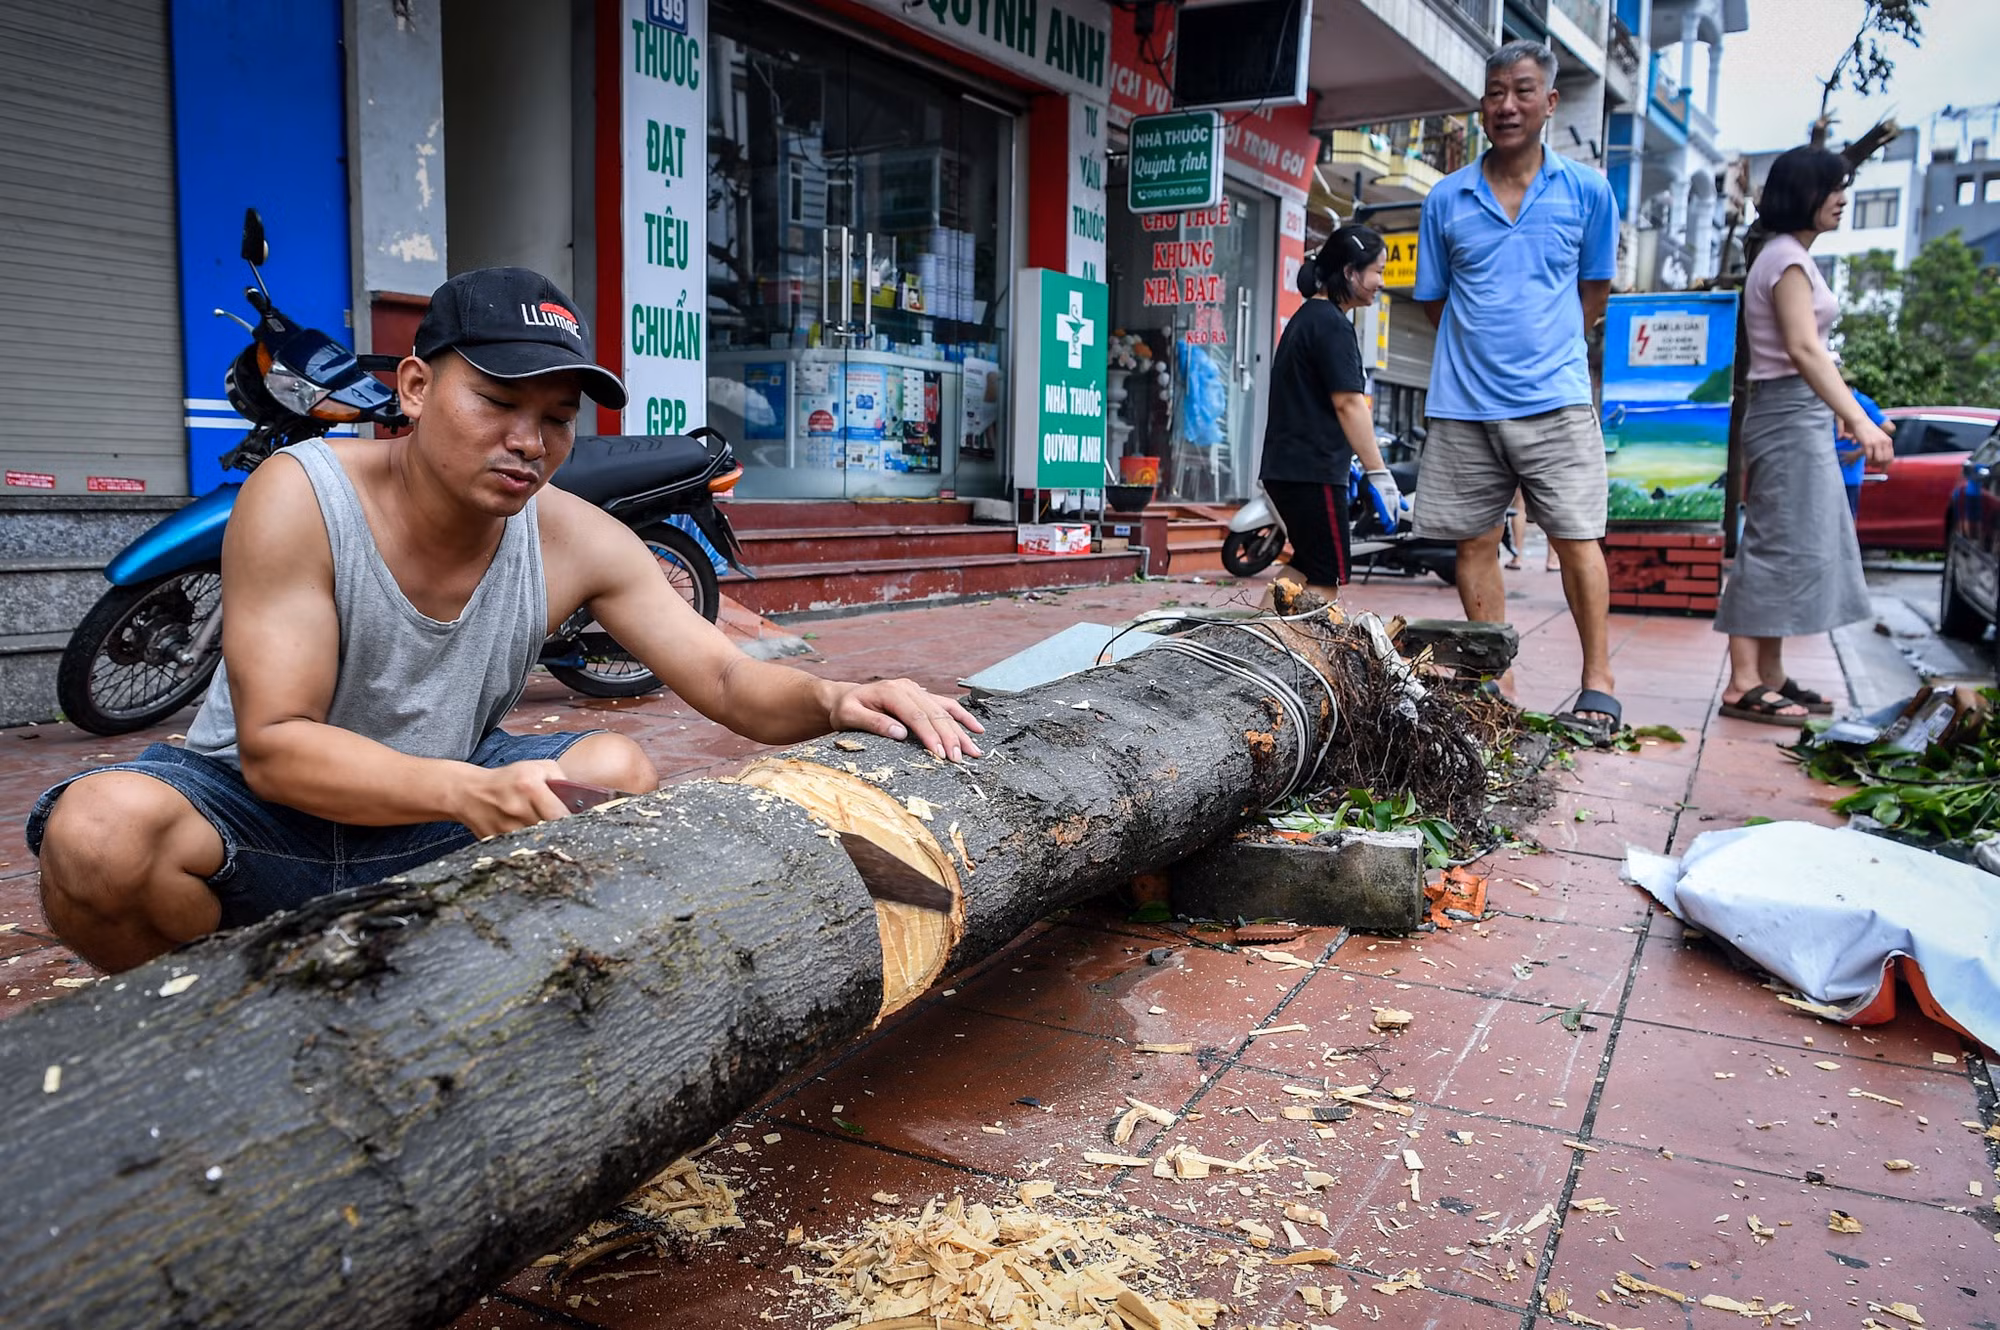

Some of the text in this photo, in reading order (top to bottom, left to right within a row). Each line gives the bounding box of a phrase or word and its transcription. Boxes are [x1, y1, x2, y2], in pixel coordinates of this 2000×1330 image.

[653, 0, 684, 24] 199
[1046, 8, 1105, 88] ANH
[646, 119, 687, 188] ĐẠT
[1136, 124, 1209, 148] NHÀ THUỐC
[1180, 151, 1208, 174] Anh
[644, 206, 688, 270] TIÊU
[1154, 241, 1213, 270] KHUNG
[1144, 269, 1219, 309] NHÀ BẠT
[632, 289, 701, 361] CHUẨN
[647, 397, 687, 436] GPP
[1045, 380, 1102, 417] NHÀ THUỐC
[1043, 428, 1101, 464] QUỲNH ANH
